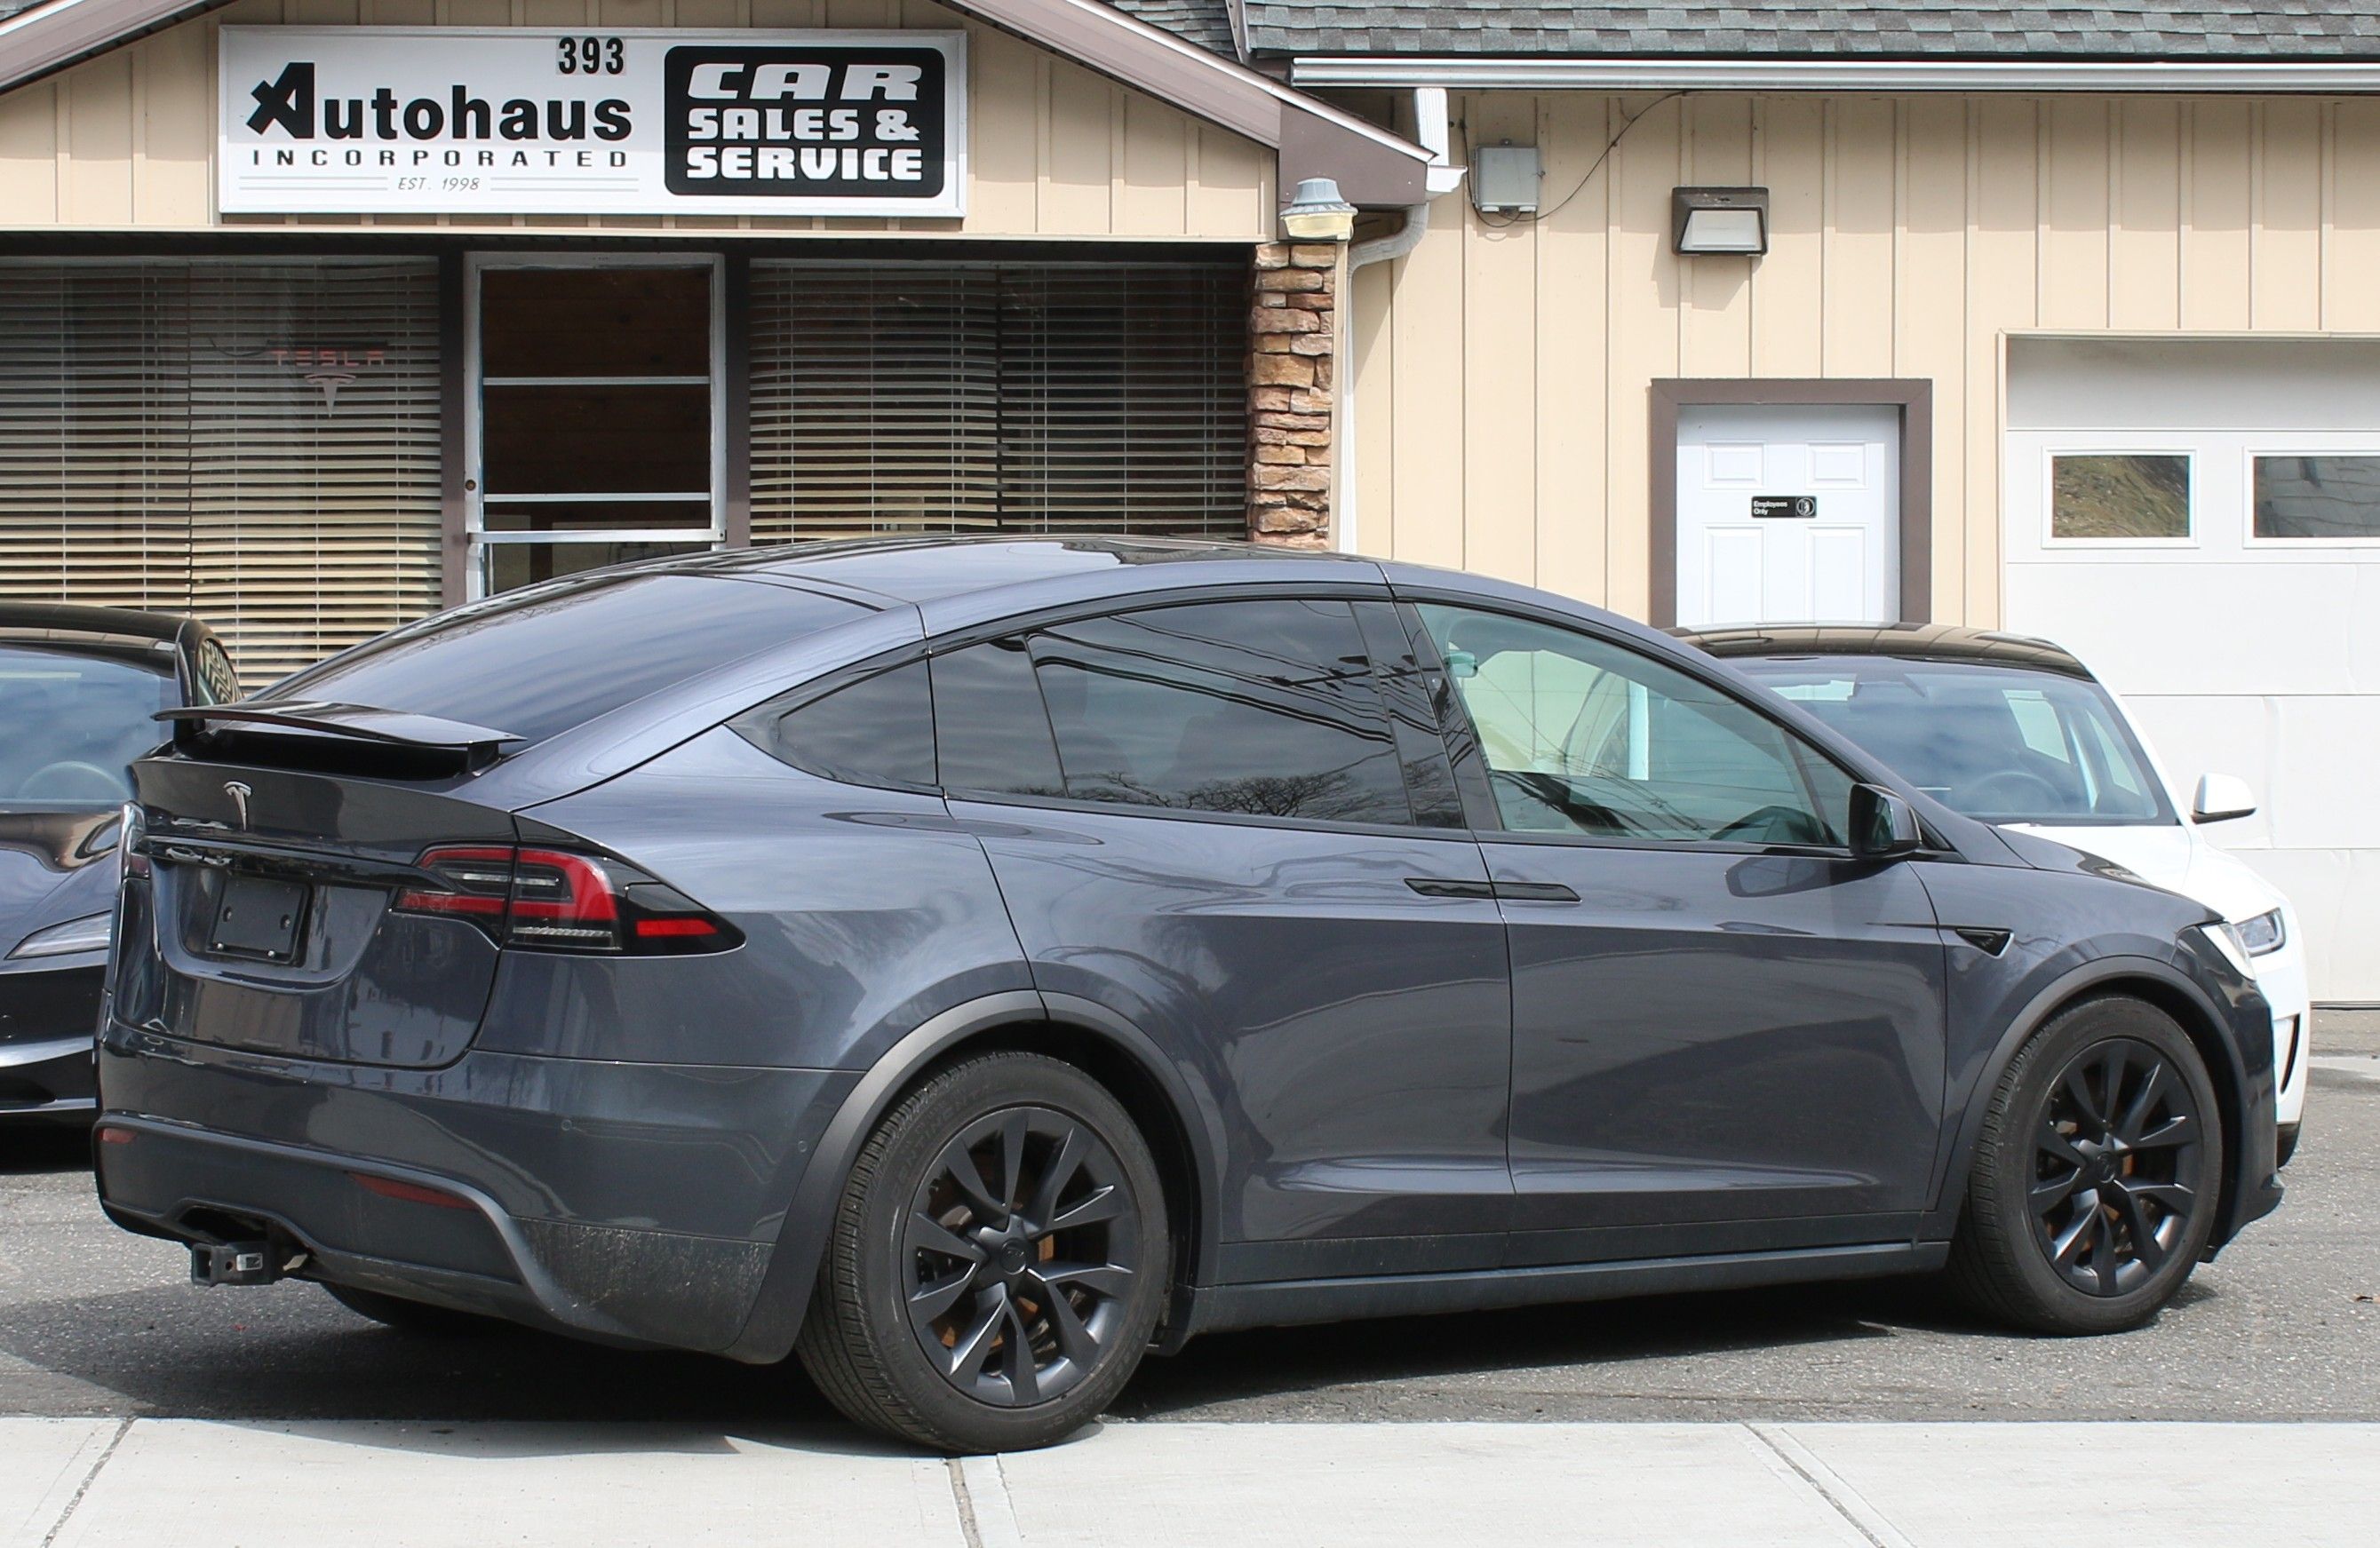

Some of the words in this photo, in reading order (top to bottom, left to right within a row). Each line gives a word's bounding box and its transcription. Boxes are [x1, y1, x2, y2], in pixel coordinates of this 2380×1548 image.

[558, 36, 625, 75] 393
[688, 63, 922, 100] CAR
[245, 61, 633, 141] Autohaus
[688, 107, 859, 141] SALES
[875, 109, 920, 141] &
[253, 149, 626, 167] INCORPORATED
[687, 147, 923, 180] SERVICE
[398, 177, 432, 190] EST.
[442, 177, 481, 192] 1998
[270, 351, 384, 367] TESLA
